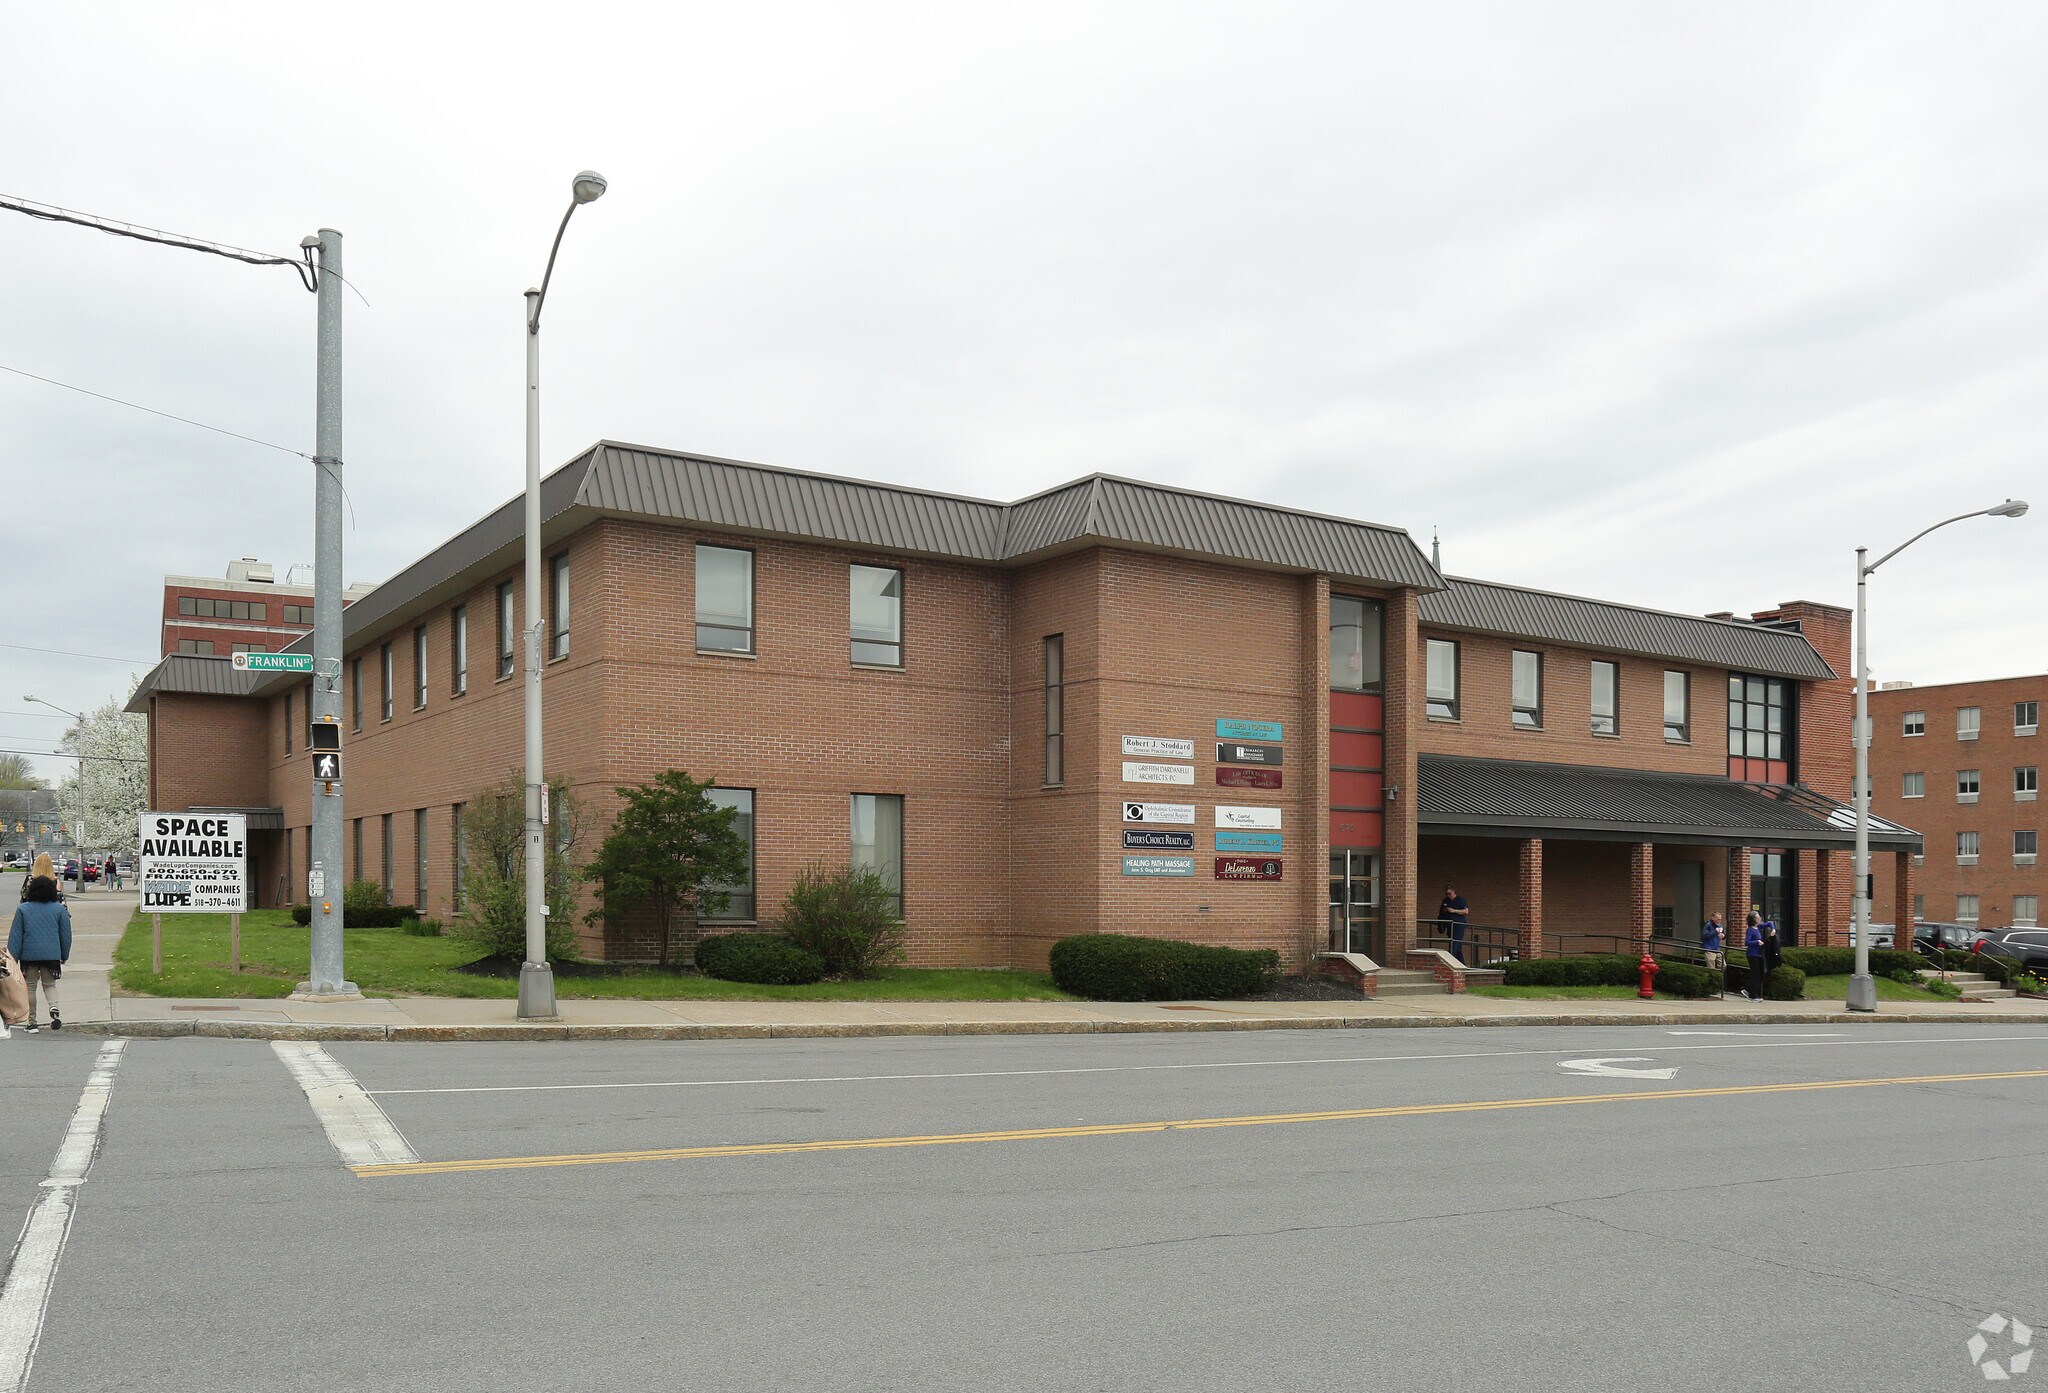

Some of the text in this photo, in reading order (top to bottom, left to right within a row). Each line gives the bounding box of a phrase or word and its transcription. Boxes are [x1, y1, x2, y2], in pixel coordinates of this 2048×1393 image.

[248, 656, 304, 668] FRANKLIN
[1126, 738, 1149, 747] Robert
[1161, 742, 1190, 750] Stoddard
[156, 818, 228, 837] SPACE
[1146, 834, 1164, 844] CHOICE
[142, 839, 243, 858] AVAILABLE
[144, 880, 191, 894] WADE
[195, 885, 240, 894] COMPANIES
[144, 893, 191, 906] LUPE
[195, 898, 240, 907] 518-370-4611
